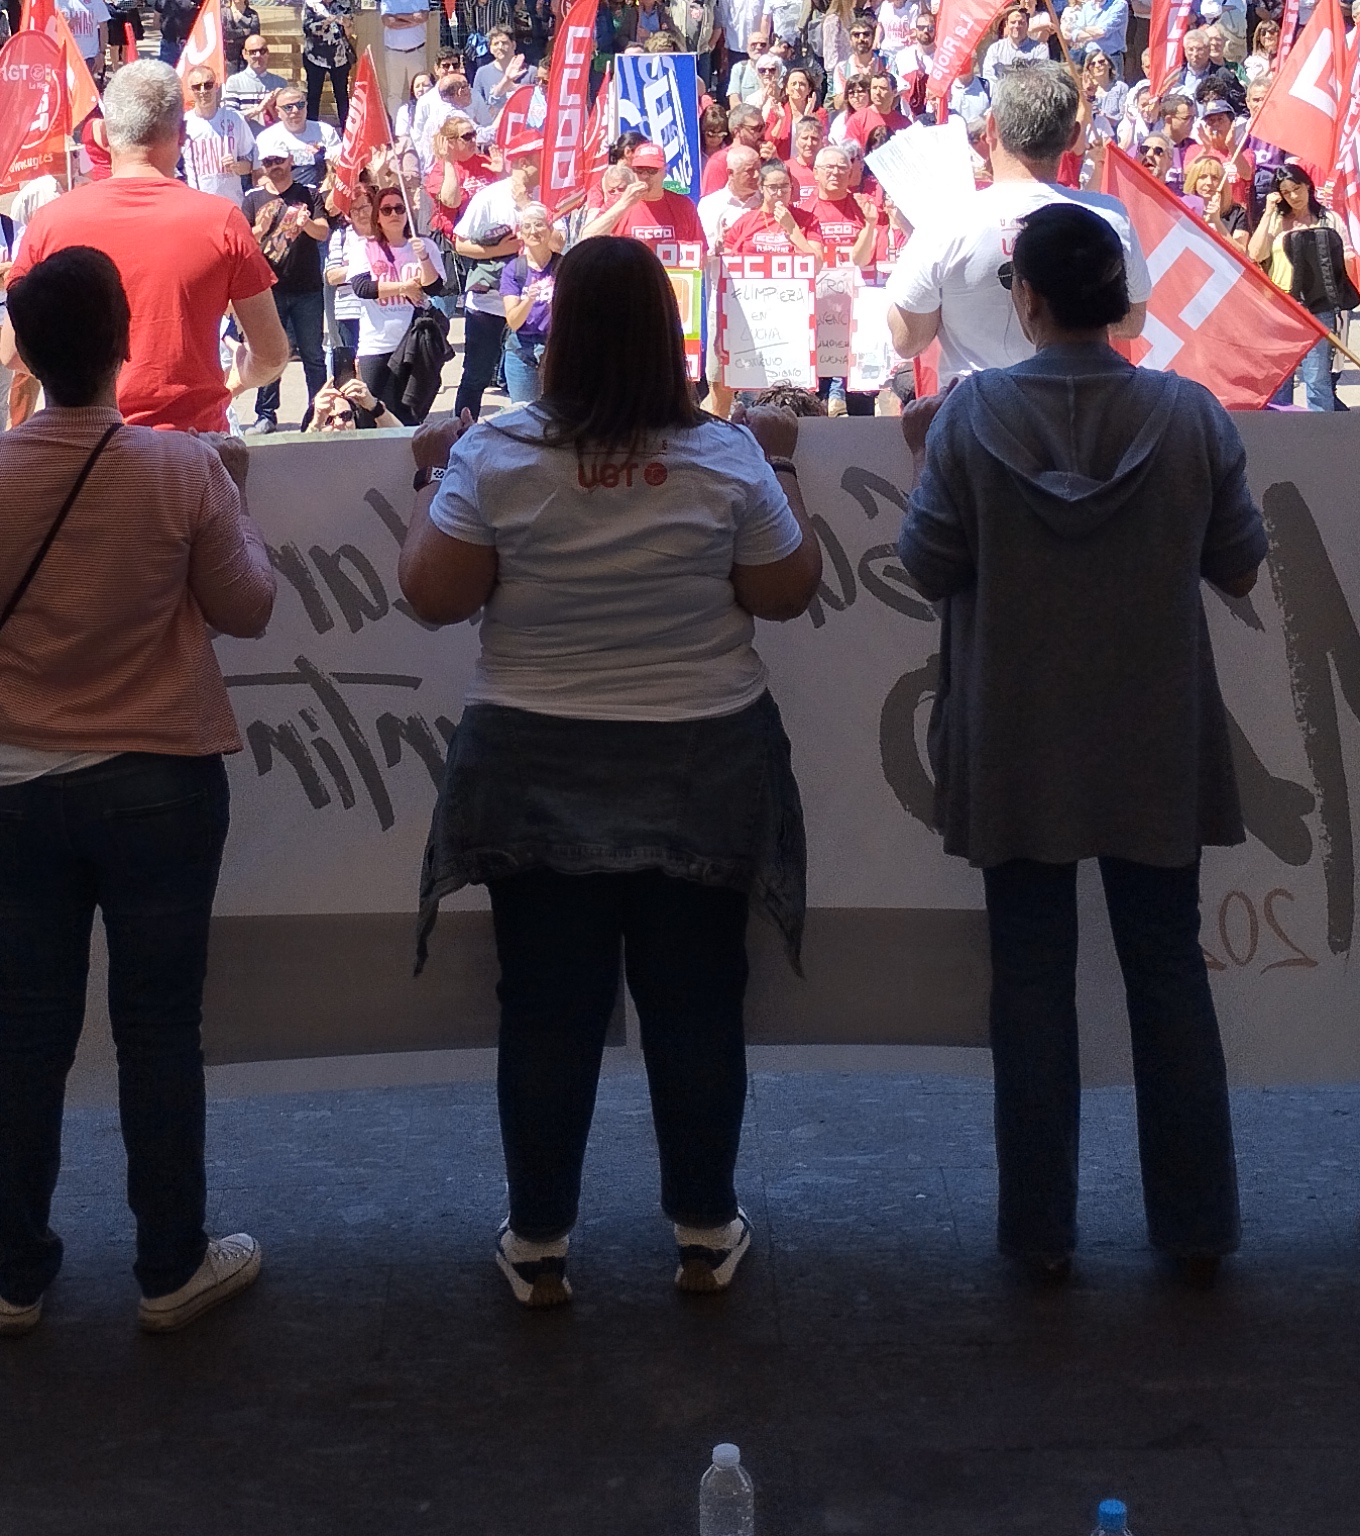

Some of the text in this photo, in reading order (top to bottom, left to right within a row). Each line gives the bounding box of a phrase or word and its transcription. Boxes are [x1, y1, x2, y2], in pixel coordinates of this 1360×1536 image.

[551, 26, 590, 190] CCOO
[635, 228, 672, 239] CCOO
[656, 243, 700, 268] OO
[723, 255, 815, 279] CCOO
[751, 311, 768, 320] EN
[740, 328, 782, 341] LUCHA
[577, 463, 639, 489] UGT
